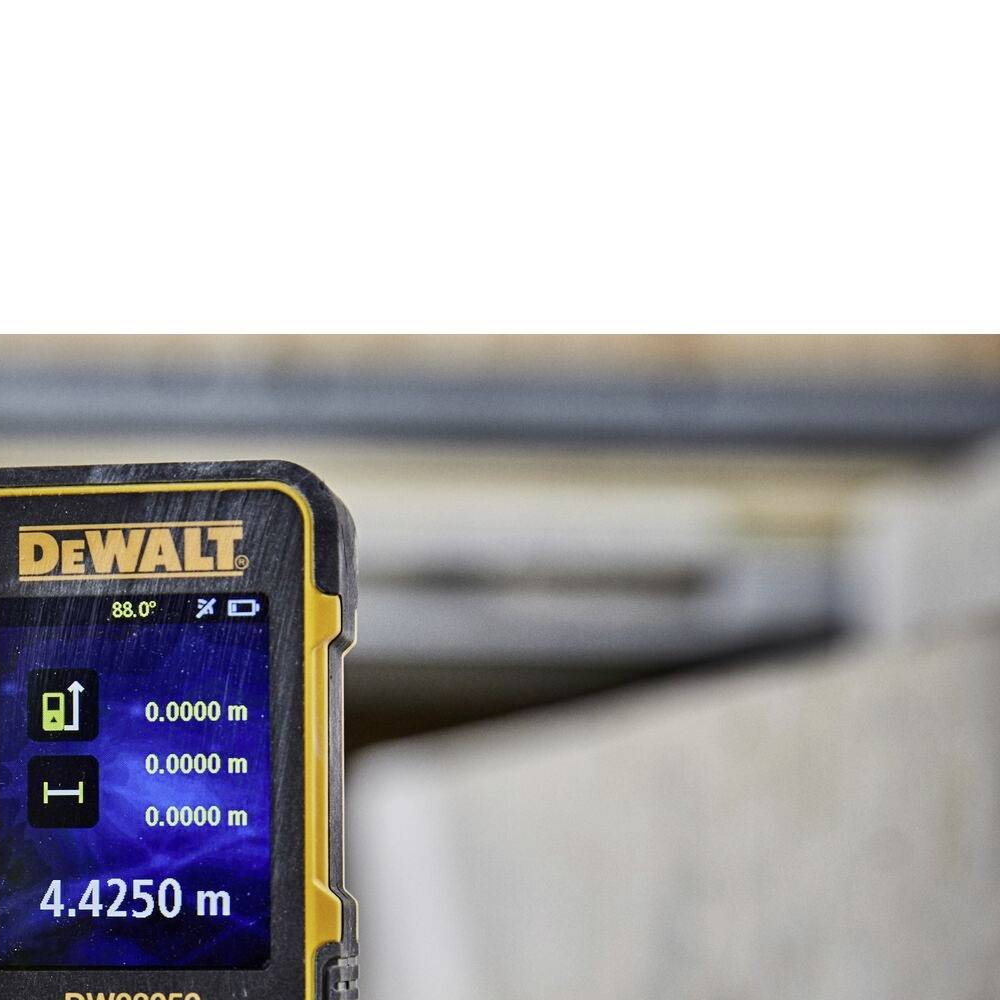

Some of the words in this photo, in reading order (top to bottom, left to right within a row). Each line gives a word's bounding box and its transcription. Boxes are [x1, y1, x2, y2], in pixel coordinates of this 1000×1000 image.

[112, 600, 157, 619] 88.0°
[145, 701, 221, 722] 0.0000
[228, 703, 248, 721] m
[145, 753, 221, 774] 0.0000
[228, 756, 248, 774] m
[145, 806, 221, 827] 0.0000
[228, 808, 248, 826] m
[40, 878, 182, 918] 4.4250
[197, 889, 231, 916] m
